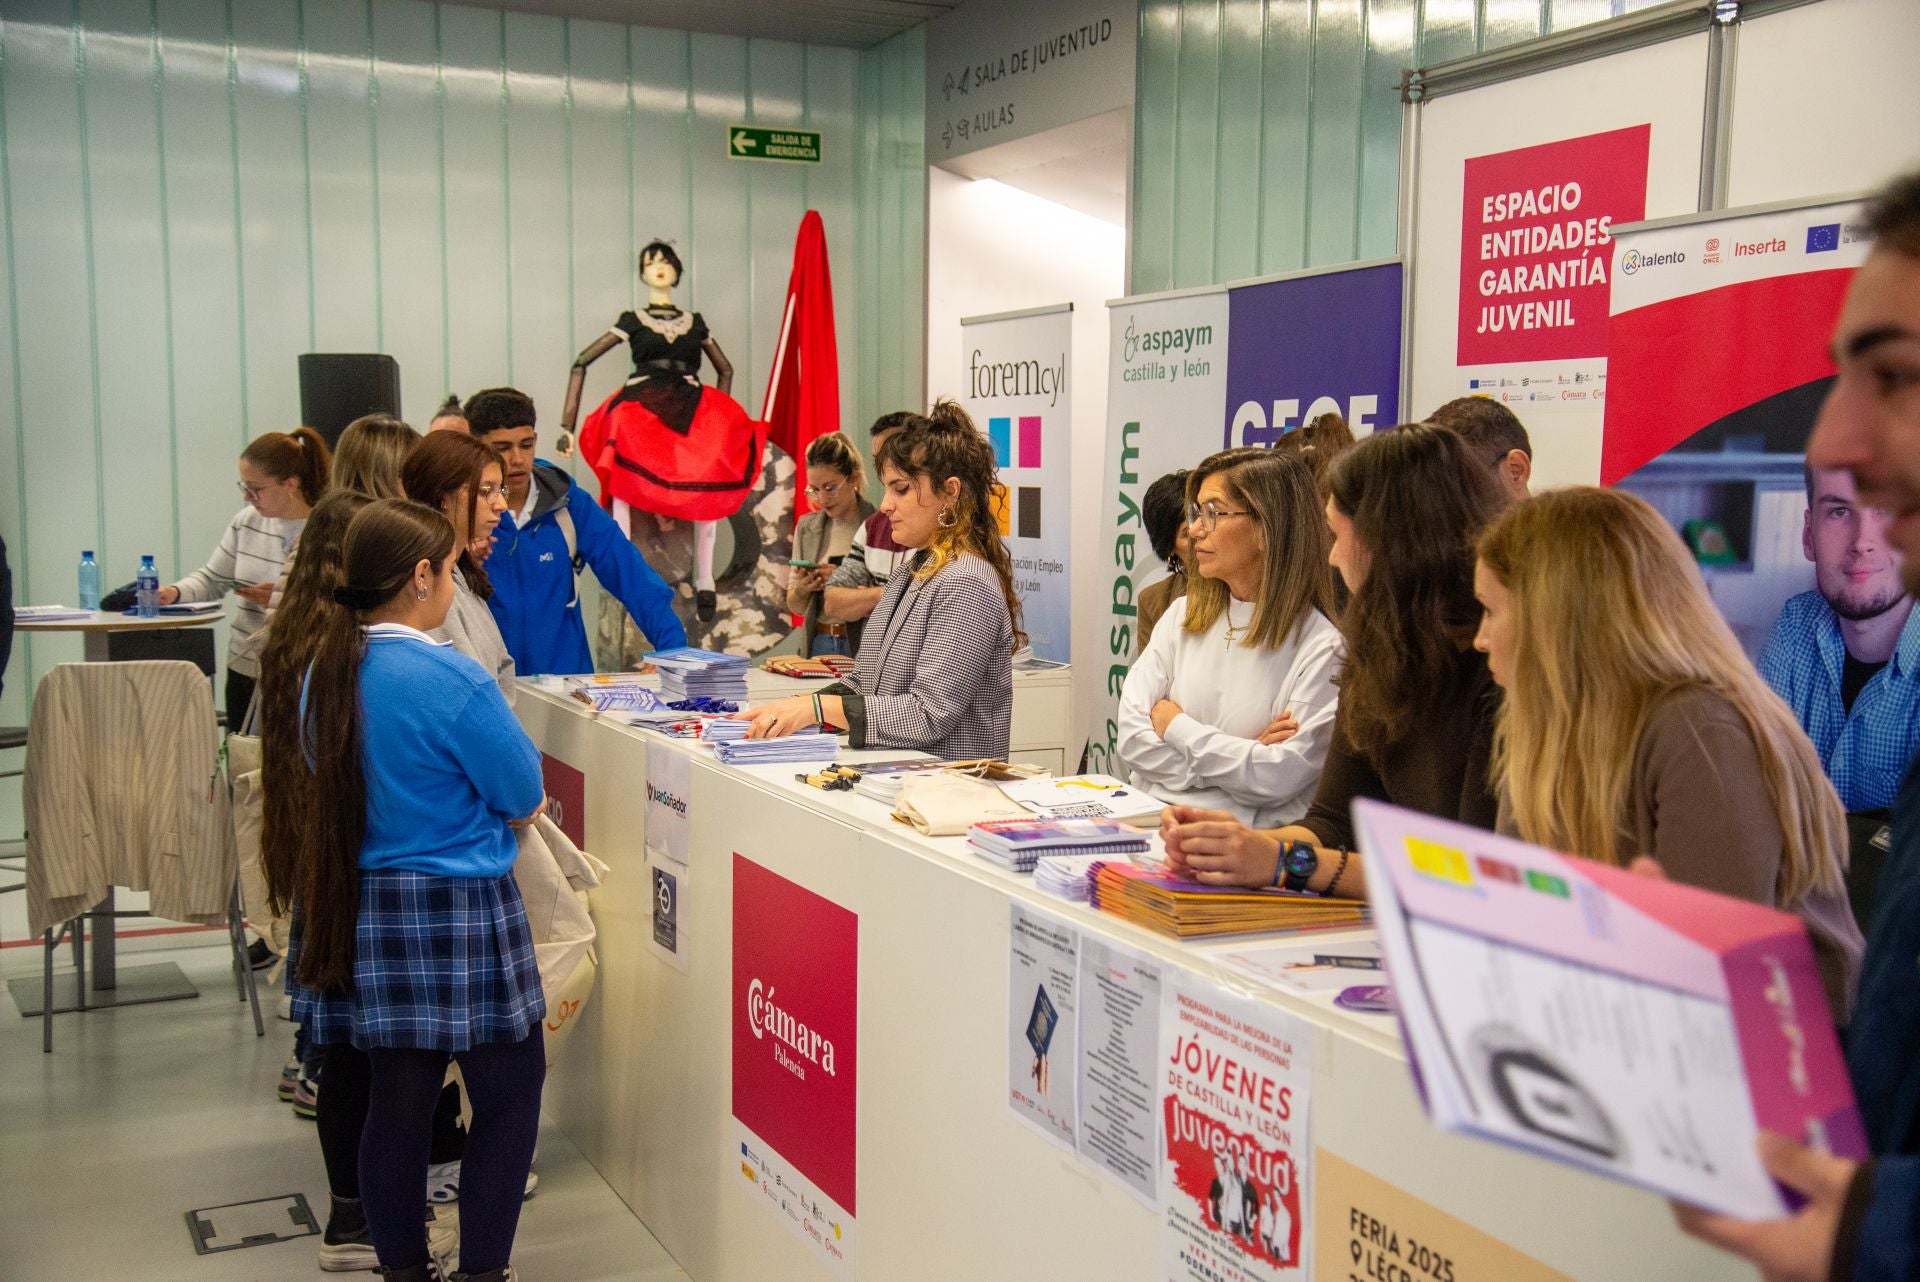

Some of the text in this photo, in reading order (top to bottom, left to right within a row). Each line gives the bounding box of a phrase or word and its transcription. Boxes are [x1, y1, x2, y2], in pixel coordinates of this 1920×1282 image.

[975, 18, 1112, 88] SALA DE JUVENTUD
[973, 103, 1015, 134] AULAS
[765, 144, 818, 158] EMERGENCIA
[770, 133, 812, 147] SALIDA DE
[1482, 181, 1582, 224] ESPACIO
[1480, 215, 1613, 260] ENTIDADES
[1735, 237, 1787, 257] Inserta
[1479, 248, 1607, 297] GARANTÍA
[1702, 256, 1720, 265] ONCE
[1476, 298, 1575, 334] JUVENIL
[1142, 324, 1213, 356] aspaym
[969, 348, 1065, 408] foremcyl
[1123, 356, 1211, 383] castilla y león
[1038, 558, 1064, 576] Empleo
[1107, 420, 1143, 700] aspaym
[1025, 577, 1041, 592] León
[747, 977, 836, 1077] Cámara
[1177, 993, 1214, 1017] PROGRAMA
[1214, 1009, 1232, 1026] PARA
[1242, 1022, 1271, 1044] MEJORA
[1179, 1008, 1230, 1041] EMPLEABILIDAD
[1240, 1039, 1253, 1052] LAS
[1253, 1043, 1291, 1071] PERSONAS
[774, 1041, 805, 1081] Palencia
[1170, 1032, 1293, 1121] JÓVENES
[1168, 1069, 1292, 1148] DE CASTILLA Y LEÓN
[1189, 1242, 1207, 1261] VEN
[1350, 1206, 1455, 1282] FERIA 2025
